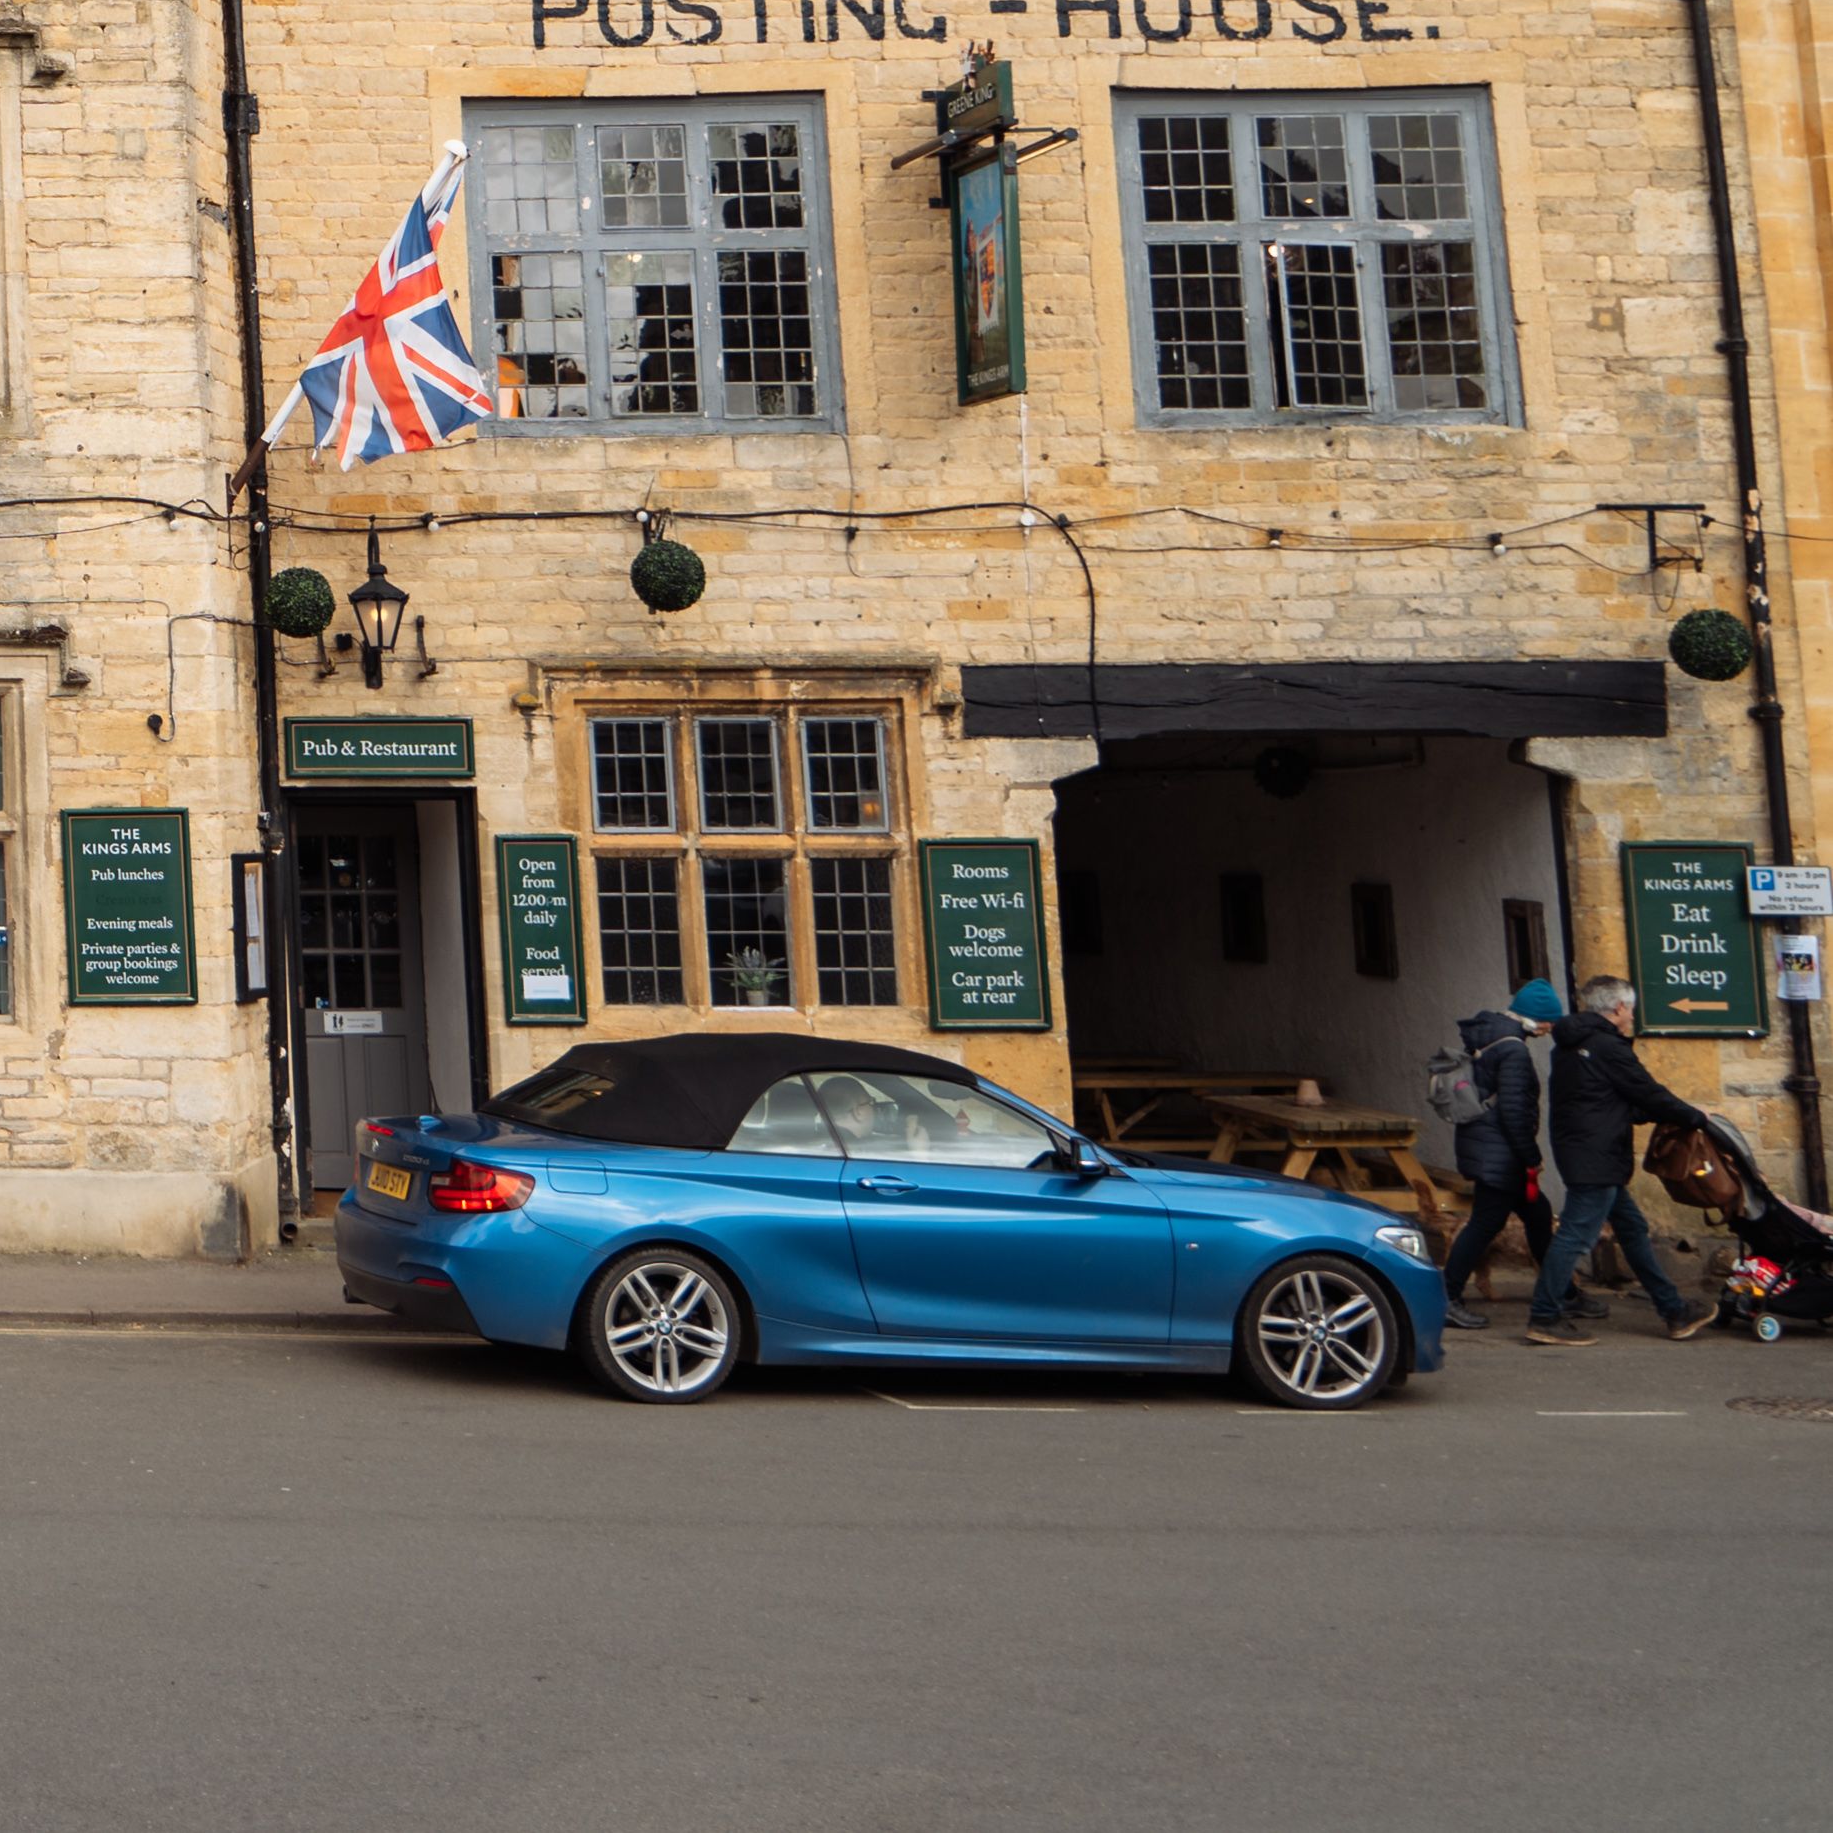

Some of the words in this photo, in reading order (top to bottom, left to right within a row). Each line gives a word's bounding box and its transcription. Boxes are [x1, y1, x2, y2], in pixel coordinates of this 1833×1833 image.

[975, 82, 994, 106] KING
[967, 372, 979, 388] THE
[302, 739, 337, 756] Pub
[341, 741, 356, 756] &
[359, 740, 457, 756] Restaurant
[111, 828, 141, 840] THE
[82, 843, 128, 855] KINGS
[131, 842, 172, 855] ARMS
[519, 858, 556, 874] Open
[951, 864, 1009, 879] Rooms
[1672, 862, 1702, 874] THE
[91, 868, 115, 881] Pub
[118, 868, 165, 881] lunches
[522, 875, 555, 889] from
[1756, 871, 1771, 889] P
[1812, 872, 1827, 880] pm
[1644, 879, 1690, 891] KINGS
[1693, 879, 1734, 891] ARMS
[1785, 881, 1791, 889] 2
[1793, 881, 1820, 890] hours
[940, 894, 978, 909] Free
[981, 892, 1025, 909] Wi-fi
[524, 910, 557, 927] daily
[1671, 903, 1711, 923] Eat
[87, 917, 136, 932] Evening
[138, 916, 174, 929] meals
[963, 924, 1006, 943] Dogs
[81, 943, 124, 955] Private
[127, 942, 168, 957] parties
[170, 943, 180, 954] &
[948, 941, 1023, 957] welcome
[1660, 933, 1728, 954] Drink
[525, 946, 560, 961] Food
[85, 960, 122, 973] group
[123, 957, 178, 972] bookings
[521, 964, 566, 977] served
[105, 973, 160, 985] welcome
[952, 971, 982, 987] Car
[986, 970, 1024, 991] park
[1665, 964, 1727, 991] Sleep
[962, 991, 978, 1004] at
[982, 992, 1016, 1004] rear
